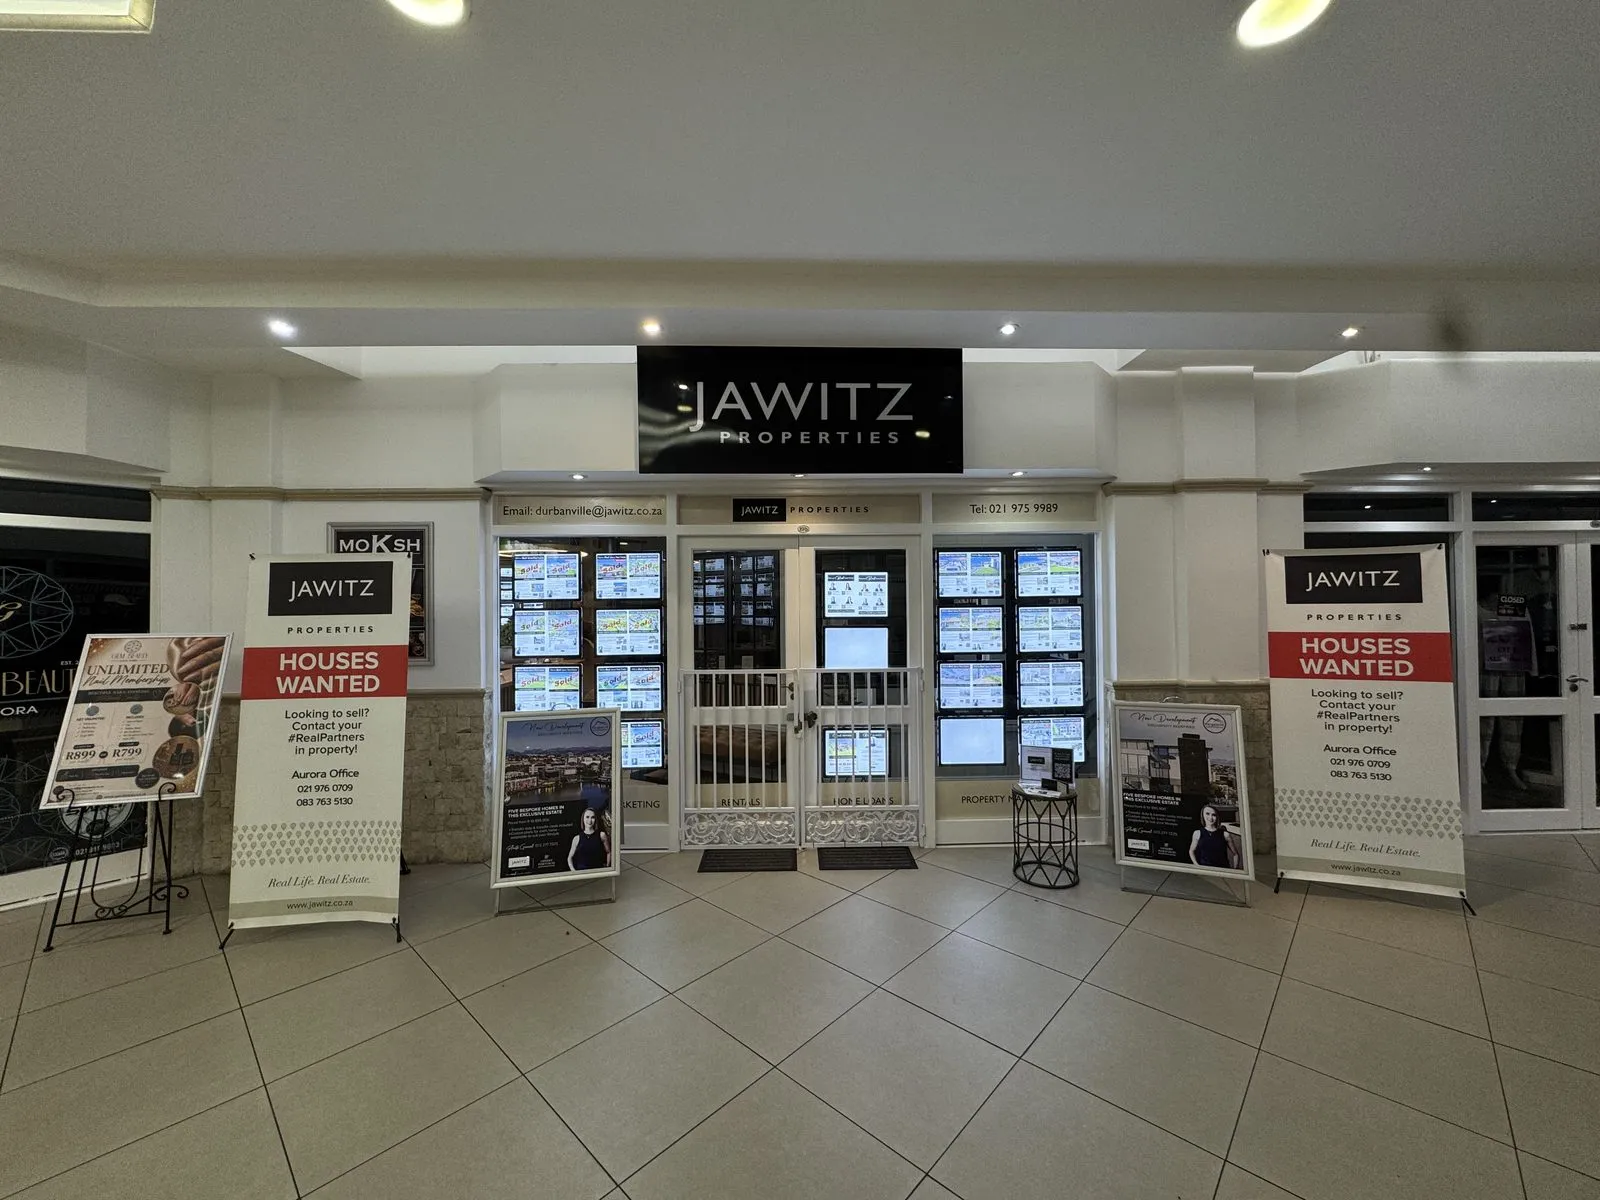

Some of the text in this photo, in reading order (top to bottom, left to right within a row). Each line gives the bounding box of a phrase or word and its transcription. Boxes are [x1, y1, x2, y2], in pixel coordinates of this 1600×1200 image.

[689, 381, 913, 433] JAWITZ
[720, 431, 899, 444] PROPERTIES
[503, 505, 663, 518] Email: durbanville@jawitz.co.za
[741, 505, 778, 515] JAWITZ
[969, 503, 1059, 514] Tel: 021 975 9989
[340, 535, 420, 553] MOKSH
[1306, 570, 1400, 591] JAWITZ
[288, 580, 374, 602] JAWITZ
[287, 626, 374, 634] PROPERTIES
[1302, 638, 1410, 654] HOUSES
[280, 652, 379, 672] HOUSES
[1300, 658, 1413, 676] WANTED
[87, 664, 169, 675] UNLIMITED
[2, 668, 76, 697] BEAUT
[83, 675, 171, 687] Nail Memberships
[276, 675, 380, 694] WANTED
[1312, 689, 1403, 700] Looking to sell?
[1, 705, 38, 716] ORA
[1319, 700, 1395, 712] Contact your
[285, 708, 370, 720] Looking to sell?
[1316, 711, 1400, 723] #RealPartners
[292, 721, 362, 732] Contact your
[1324, 721, 1393, 734] in property!
[288, 732, 365, 743] #RealPartners
[66, 750, 96, 760] R899
[113, 748, 141, 757] R799
[295, 743, 358, 756] in property!
[1323, 744, 1397, 756] Aurora Office
[1330, 758, 1390, 768] 021 976 0709
[291, 768, 360, 779] Aurora Office
[1330, 770, 1392, 781] 083 763 5130
[297, 784, 353, 793] 021 976 0709
[296, 797, 353, 807] 083 763 5130
[621, 800, 660, 809] RKETING
[961, 795, 1005, 803] PROPERTY
[1311, 839, 1333, 848] Real
[1360, 842, 1384, 853] Real
[1331, 863, 1400, 876] www.jawitz.co.za
[268, 877, 291, 888] Real
[318, 875, 339, 886] Real
[287, 900, 353, 911] www.jawitz.co.za
